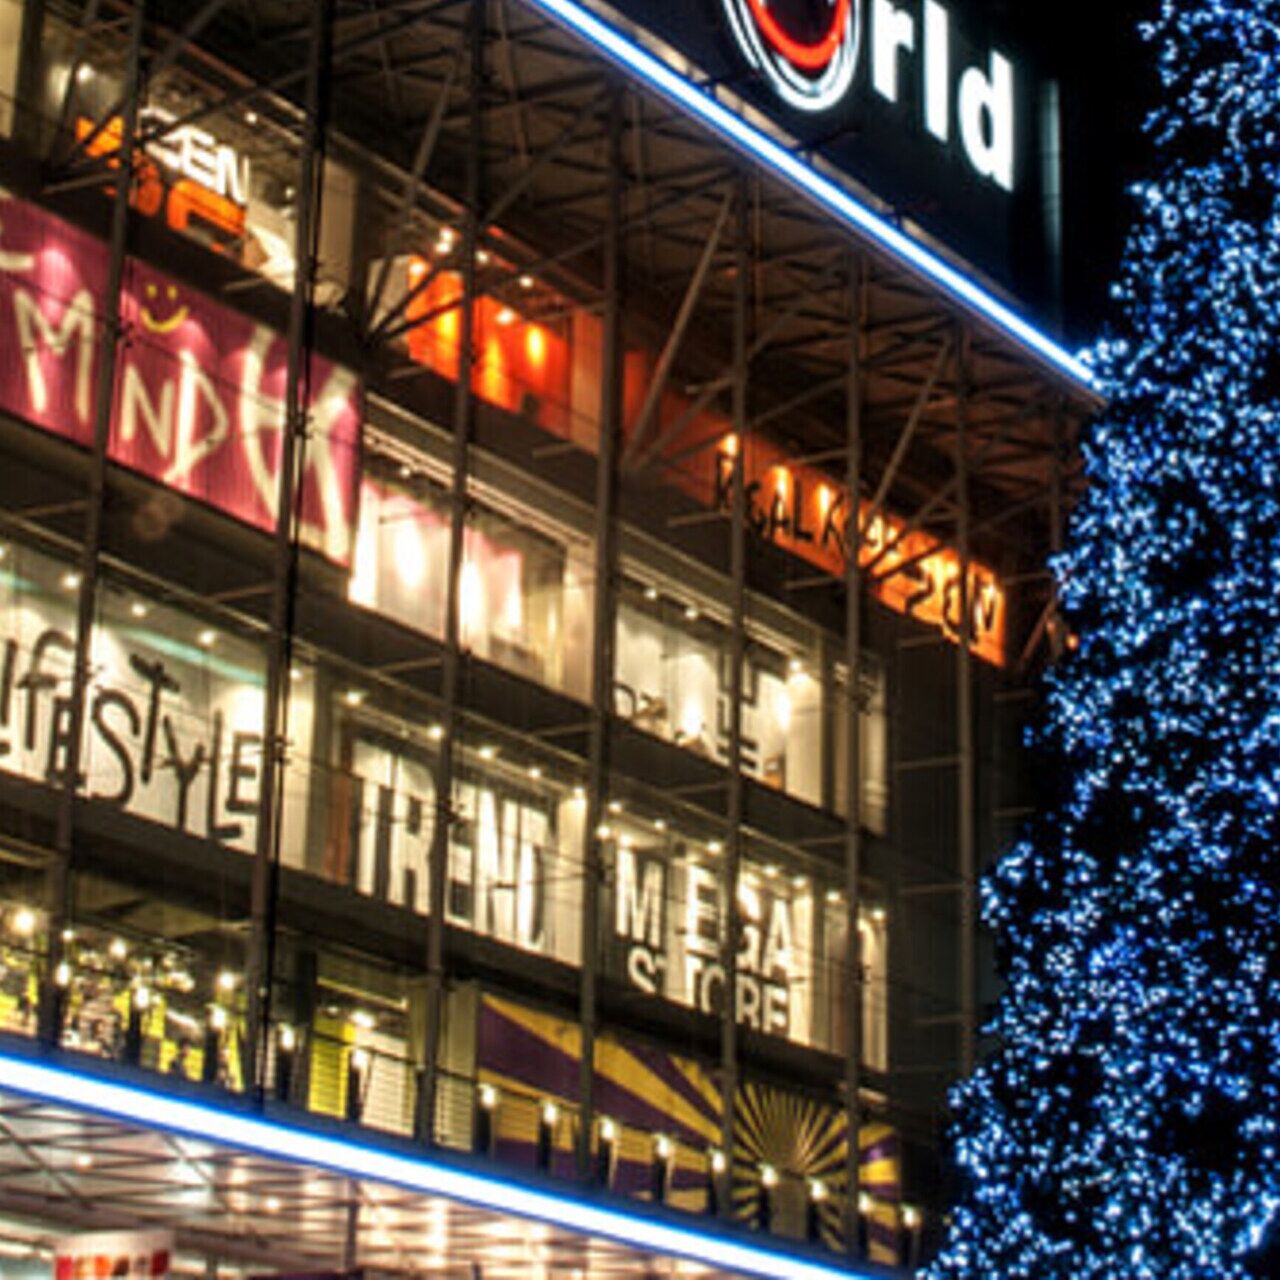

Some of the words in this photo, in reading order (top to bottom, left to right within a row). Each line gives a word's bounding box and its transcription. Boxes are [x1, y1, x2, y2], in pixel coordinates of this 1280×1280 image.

[15, 285, 228, 486] MND
[352, 741, 550, 952] TREND
[616, 846, 800, 980] MEGA
[628, 945, 790, 1035] STORE
